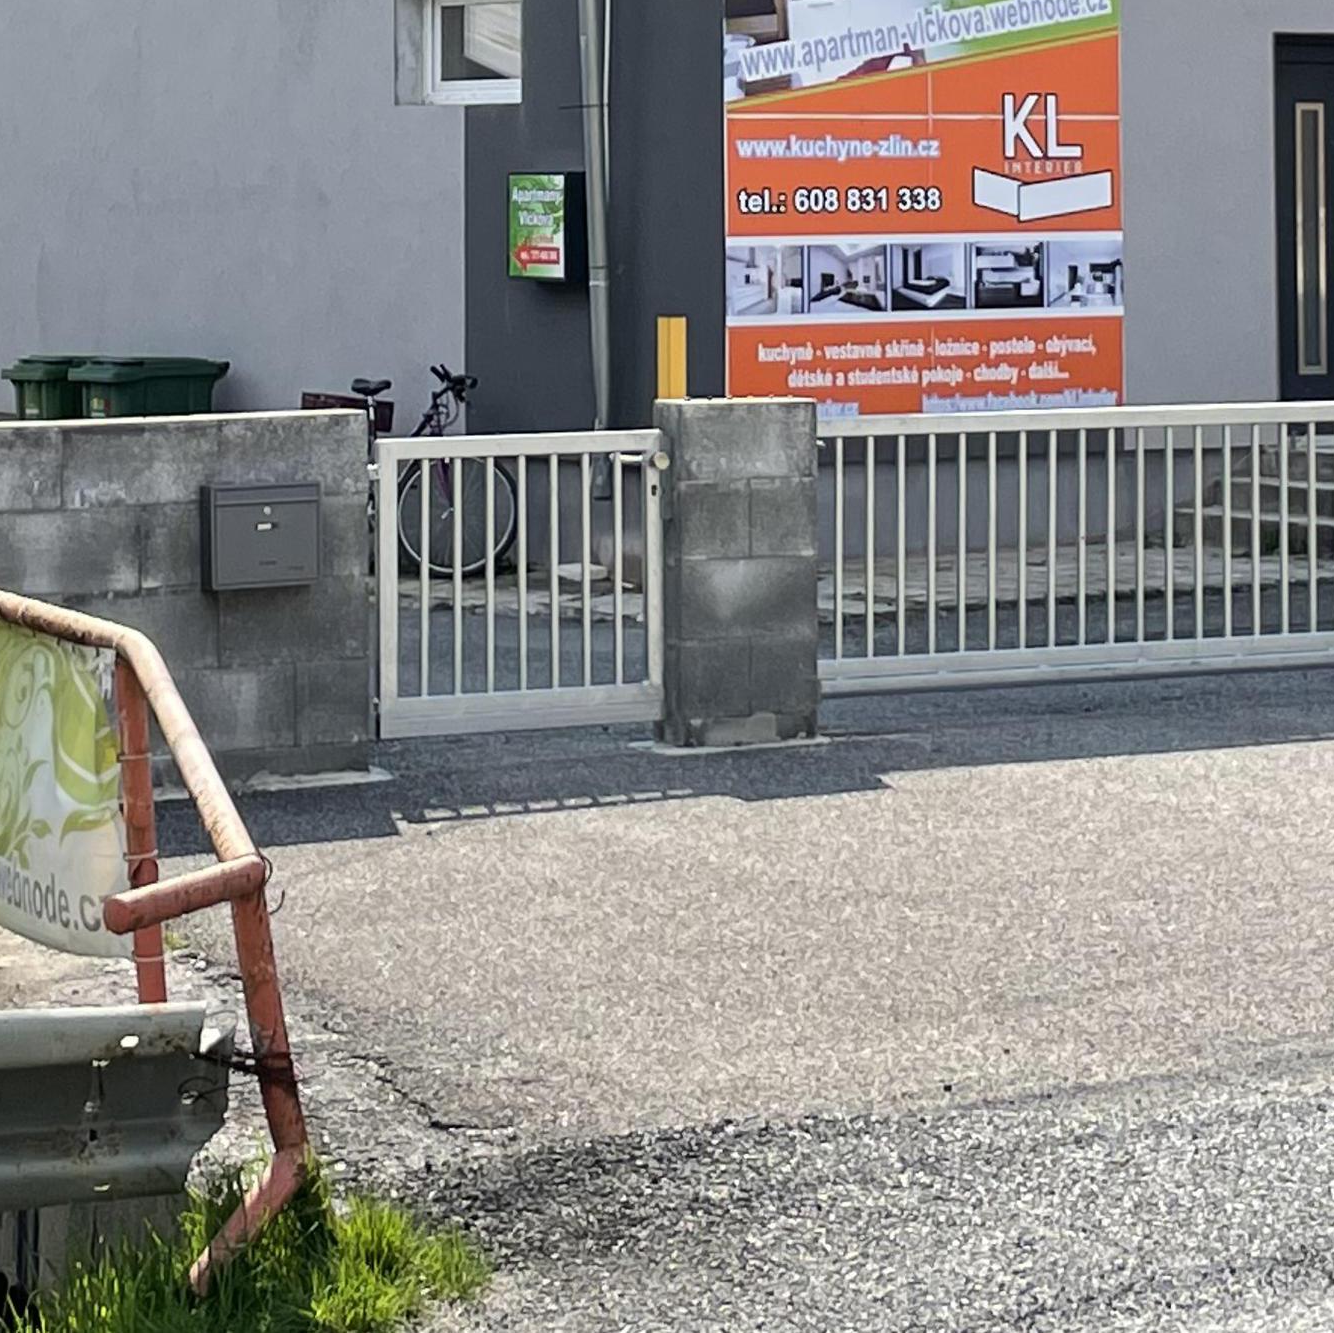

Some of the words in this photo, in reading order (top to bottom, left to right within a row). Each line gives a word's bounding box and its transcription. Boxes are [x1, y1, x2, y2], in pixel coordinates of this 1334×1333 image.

[1002, 93, 1082, 159] KL
[737, 188, 787, 213] tel.:
[794, 187, 839, 212] 608
[846, 187, 888, 212] 831
[897, 187, 942, 211] 338
[835, 371, 845, 386] a
